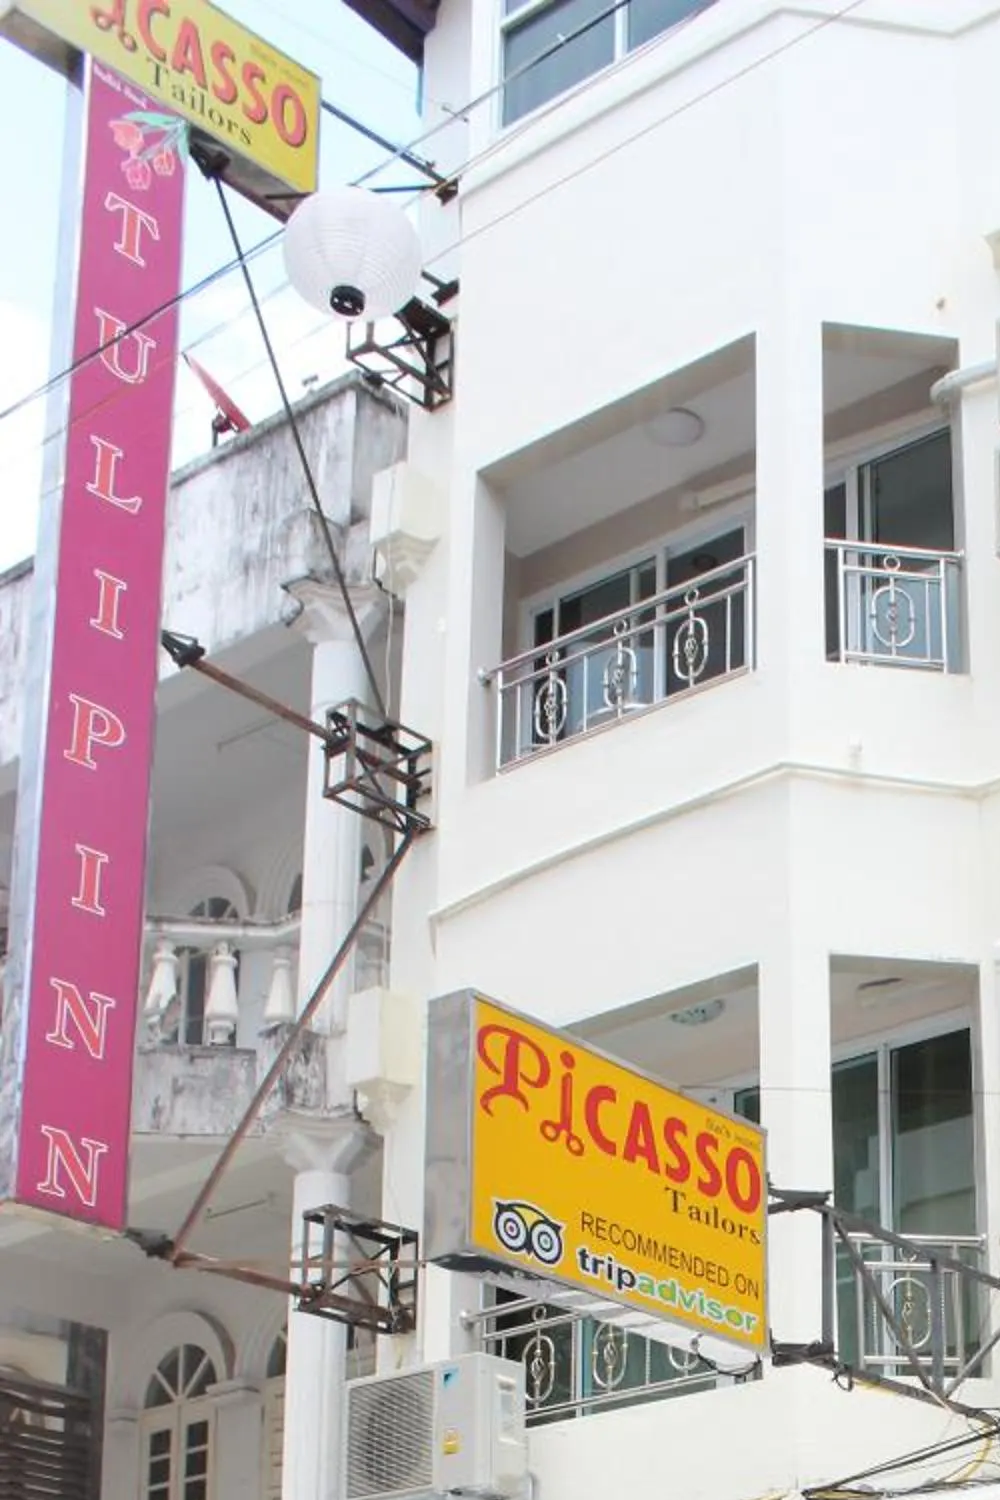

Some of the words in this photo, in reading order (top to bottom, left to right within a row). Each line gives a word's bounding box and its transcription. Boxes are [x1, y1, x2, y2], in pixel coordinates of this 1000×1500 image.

[146, 57, 252, 146] Tailors
[580, 1211, 731, 1288] RECOMMENDED
[734, 1272, 760, 1300] ON
[664, 1186, 762, 1245] Tailors
[576, 1245, 760, 1333] tripadvisor
